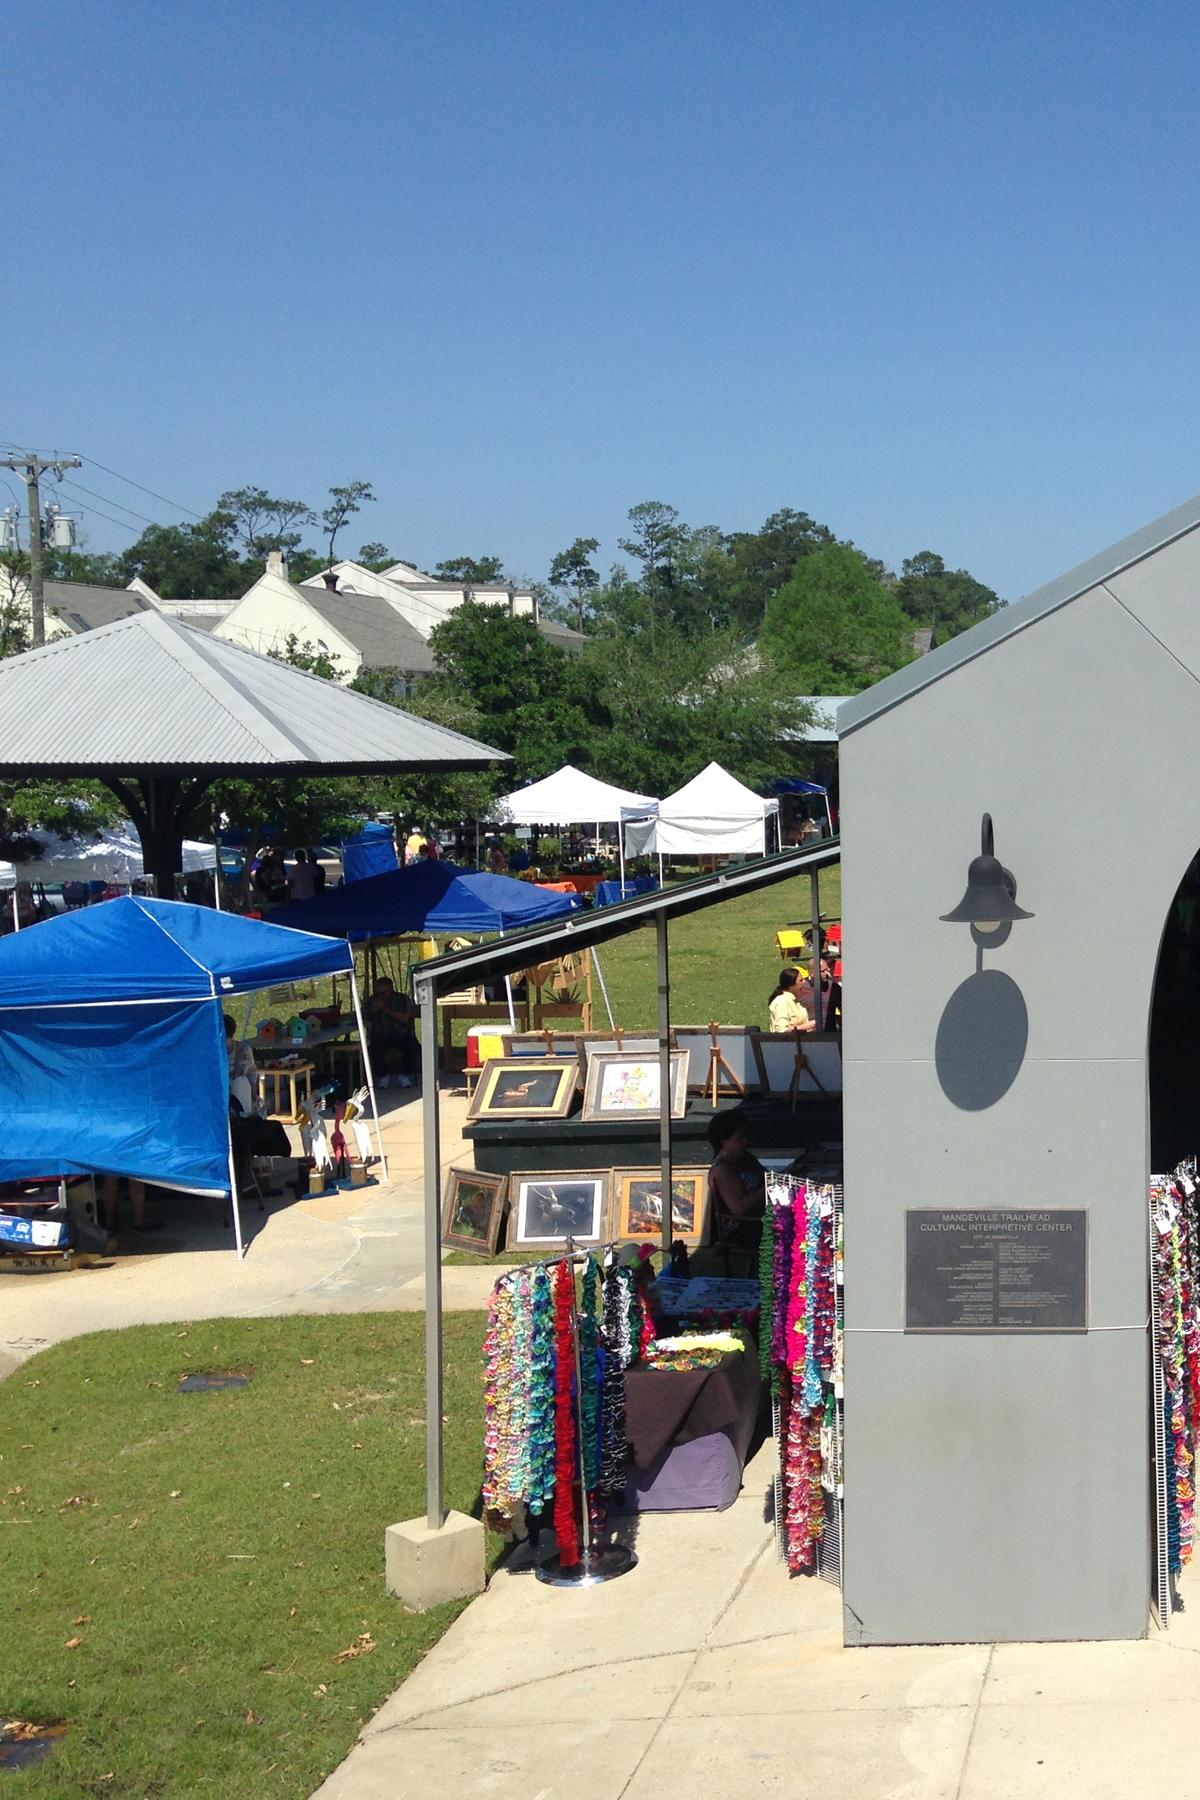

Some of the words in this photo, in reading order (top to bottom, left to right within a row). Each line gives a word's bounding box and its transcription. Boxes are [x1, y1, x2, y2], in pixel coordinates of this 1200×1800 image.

[942, 1213, 998, 1222] MANDEVILLE
[1001, 1213, 1050, 1222] TRAILHEAD
[920, 1223, 966, 1232] CULTURAL
[968, 1223, 1033, 1232] INTERPRETIVE
[1035, 1223, 1073, 1232] CENTER
